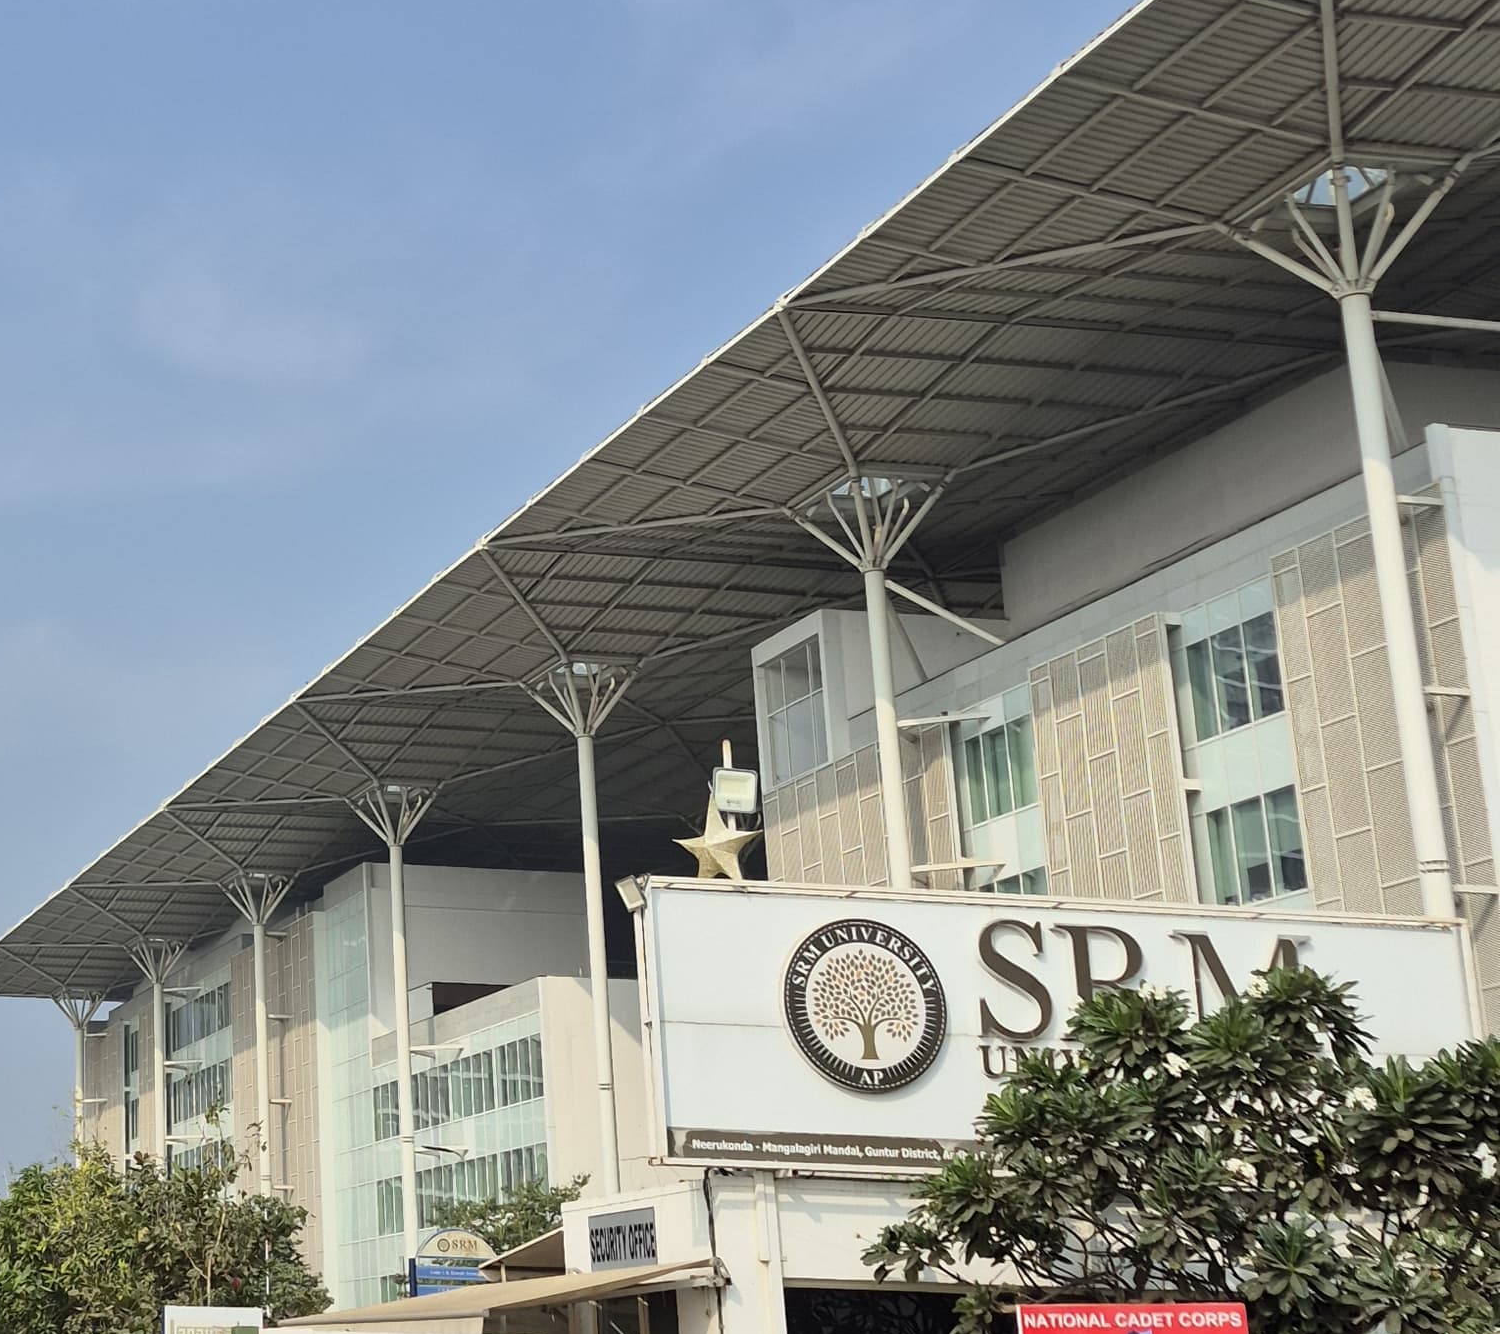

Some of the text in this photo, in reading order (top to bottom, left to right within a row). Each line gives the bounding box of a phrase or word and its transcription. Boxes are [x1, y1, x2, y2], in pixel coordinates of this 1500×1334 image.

[792, 926, 937, 991] SRM UNIVERSITY
[978, 918, 1311, 1043] SRM
[859, 1070, 884, 1086] AP
[691, 1139, 754, 1152] Neerukonda
[762, 1141, 821, 1156] Mangalagiri
[864, 1146, 900, 1158] Guntur
[451, 1239, 477, 1251] SRM
[590, 1222, 656, 1263] SECURITY OFFICE
[1023, 1312, 1242, 1328] NATIONAL CADET CORPS
